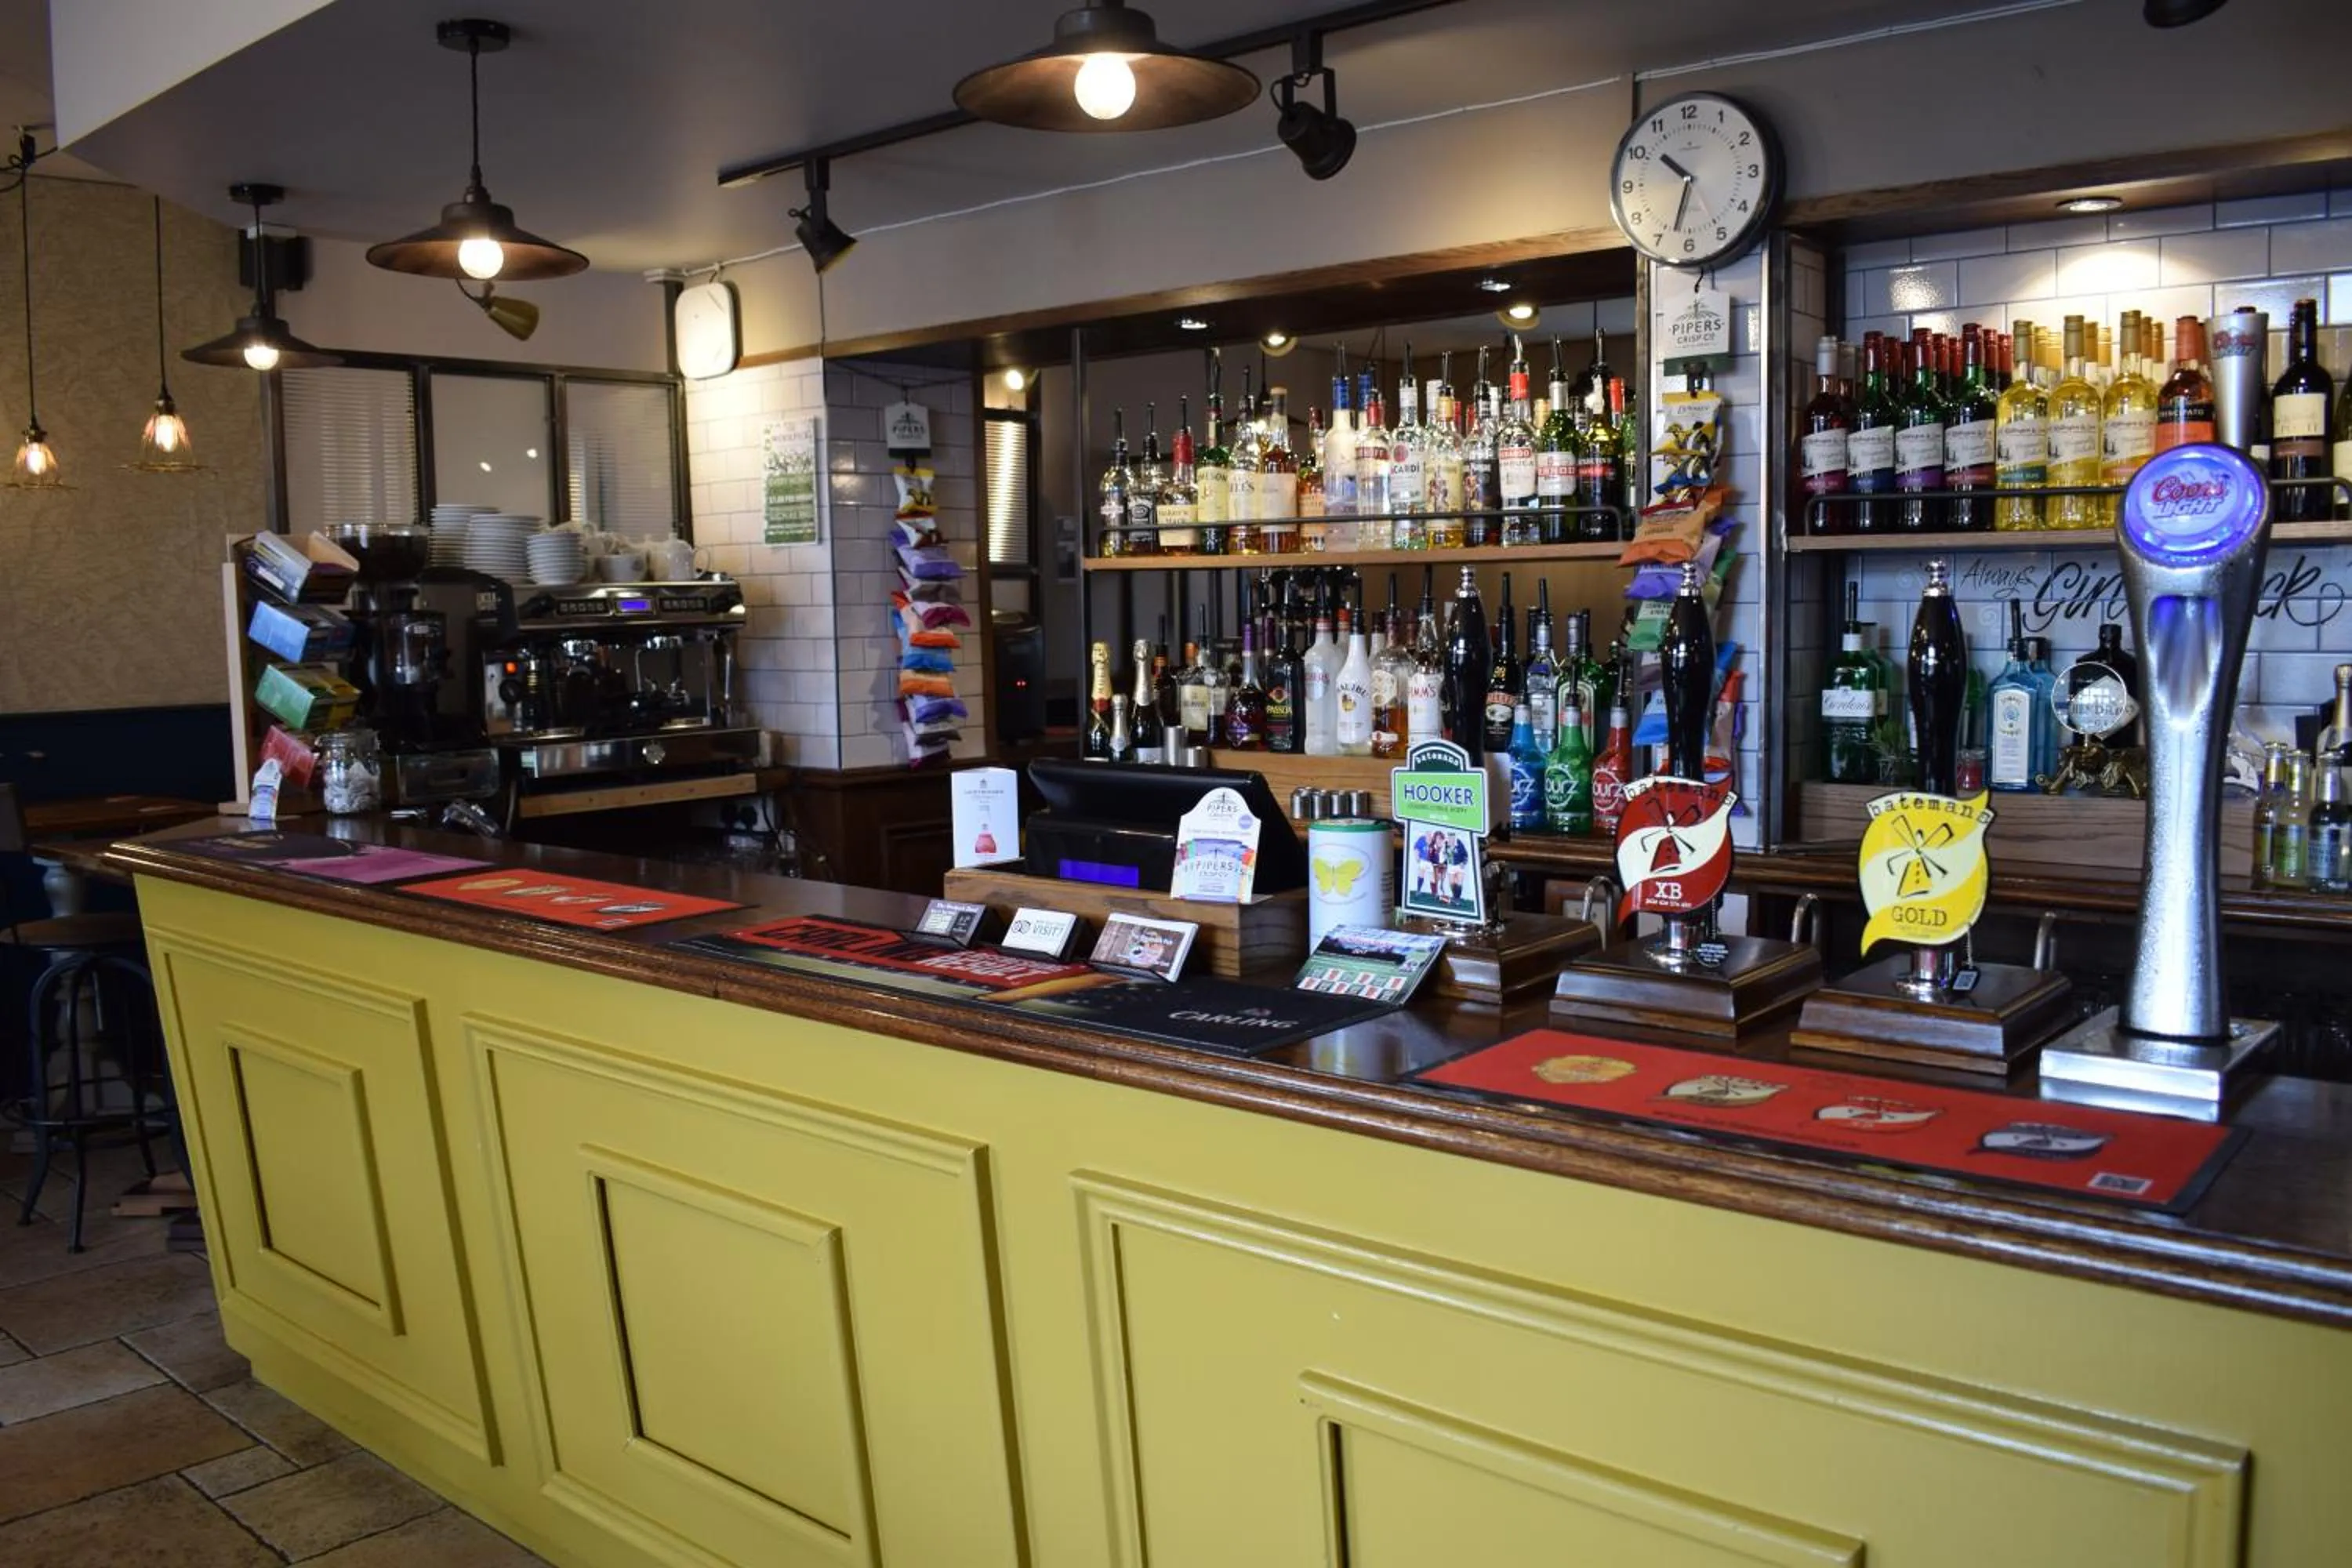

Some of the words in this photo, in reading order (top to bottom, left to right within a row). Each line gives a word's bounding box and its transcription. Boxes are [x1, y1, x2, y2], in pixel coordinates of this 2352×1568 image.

[1681, 105, 1697, 119] 12
[1718, 107, 1724, 123] 1
[1651, 119, 1664, 132] 11
[1739, 132, 1750, 146] 2
[1629, 145, 1646, 159] 10
[1748, 164, 1759, 178] 3
[1622, 180, 1633, 194] 9
[1737, 200, 1748, 213] 4
[1631, 212, 1642, 225] 8
[1653, 234, 1663, 246] 7
[1716, 227, 1727, 240] 5
[1683, 239, 1695, 252] 6
[1672, 318, 1721, 336] PIPERS
[2152, 475, 2225, 503] Coors
[2154, 497, 2222, 520] LIGHT
[1960, 558, 2038, 599] Always
[1404, 784, 1474, 805] HOOKER
[1207, 803, 1238, 813] PIPERS
[1869, 793, 1991, 824] batemans
[1196, 862, 1234, 872] PIPERS
[1655, 881, 1683, 900] XB
[1891, 906, 1947, 926] GOLD
[1168, 1010, 1300, 1029] CARLING
